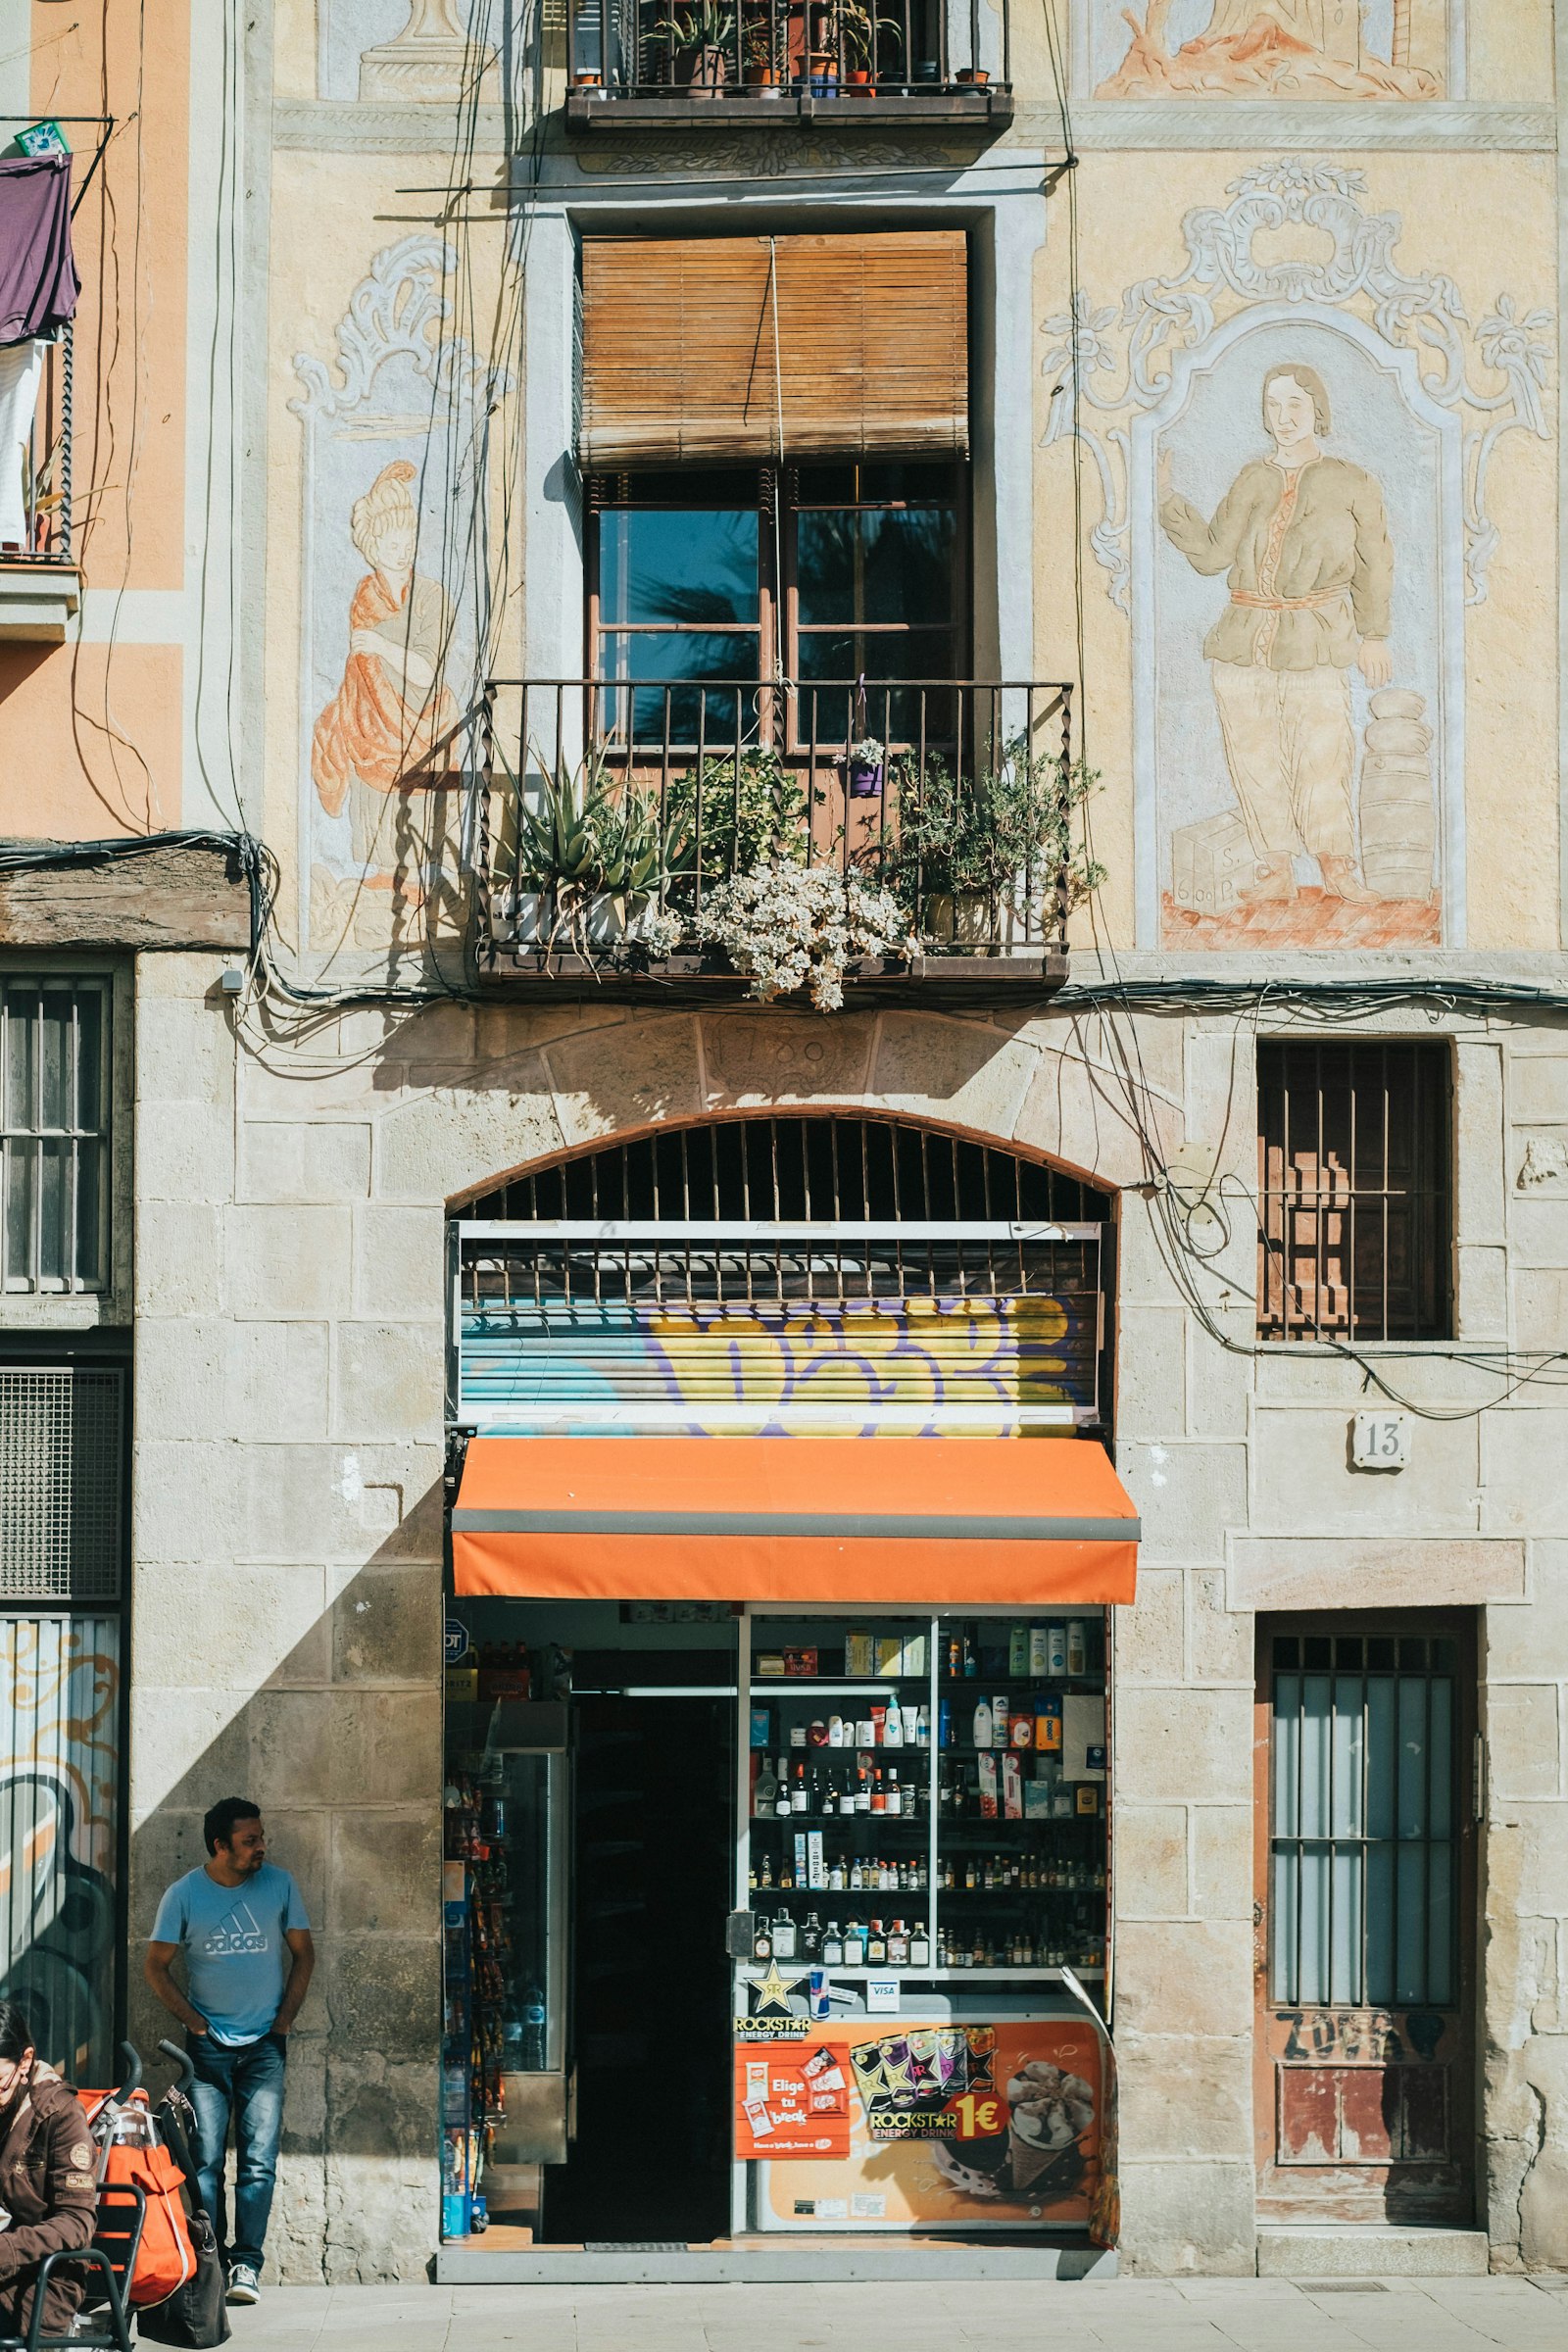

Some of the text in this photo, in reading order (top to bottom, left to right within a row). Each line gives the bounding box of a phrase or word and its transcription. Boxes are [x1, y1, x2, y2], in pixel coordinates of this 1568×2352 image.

[445, 1634, 462, 1648] DT
[203, 1933, 268, 1955] adidas
[873, 1985, 895, 1995] VISA
[772, 2079, 805, 2095] Elige
[781, 2097, 796, 2108] tu
[769, 2109, 808, 2125] break
[956, 2094, 999, 2137] 1€
[874, 2129, 956, 2137] ENERGY DRINK
